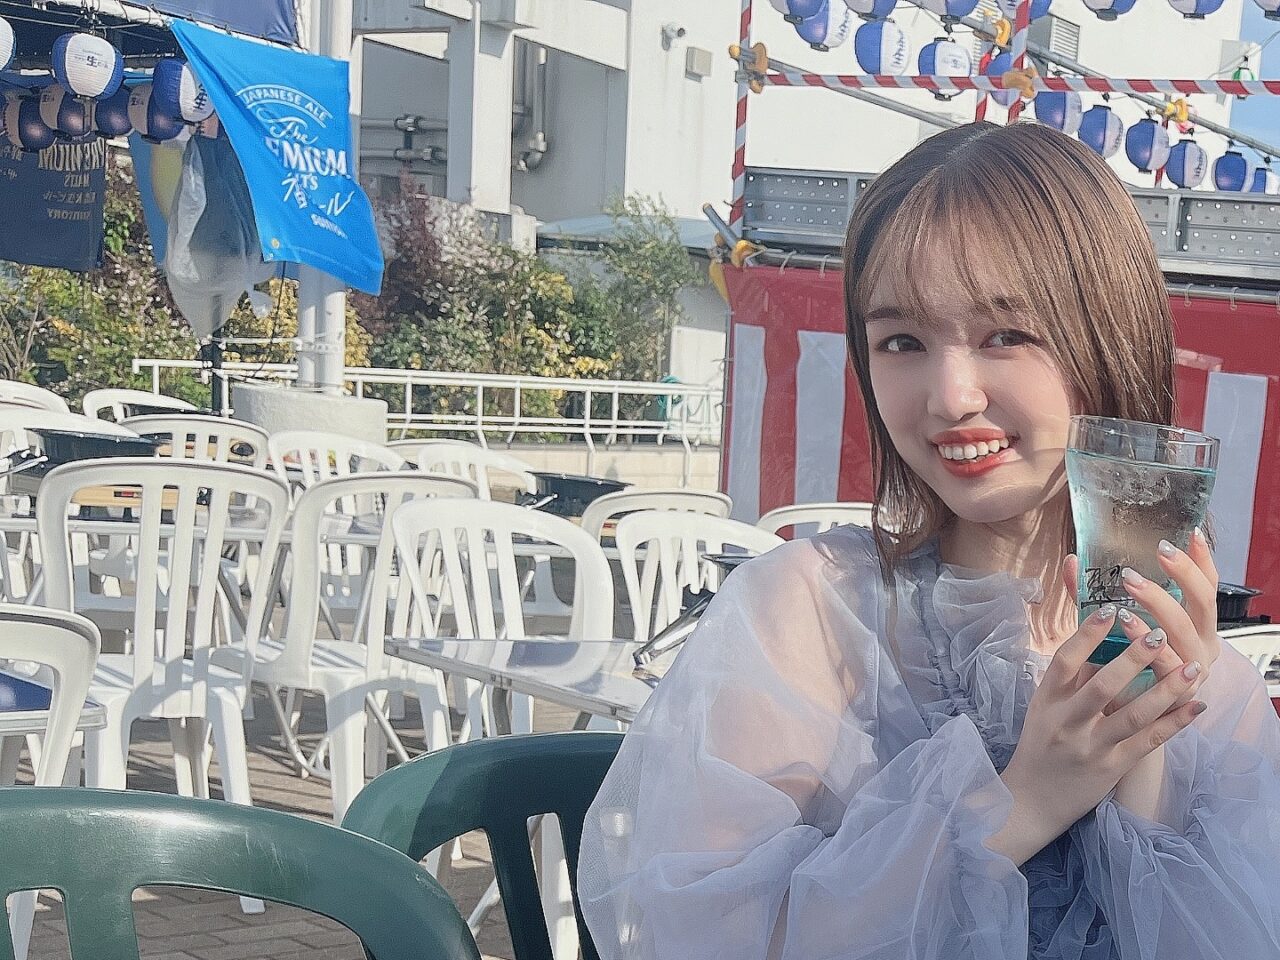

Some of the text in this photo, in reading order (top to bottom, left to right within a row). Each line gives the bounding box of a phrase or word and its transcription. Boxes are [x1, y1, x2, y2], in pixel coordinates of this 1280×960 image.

[242, 88, 329, 121] JAPANESE ALE
[256, 107, 319, 144] The
